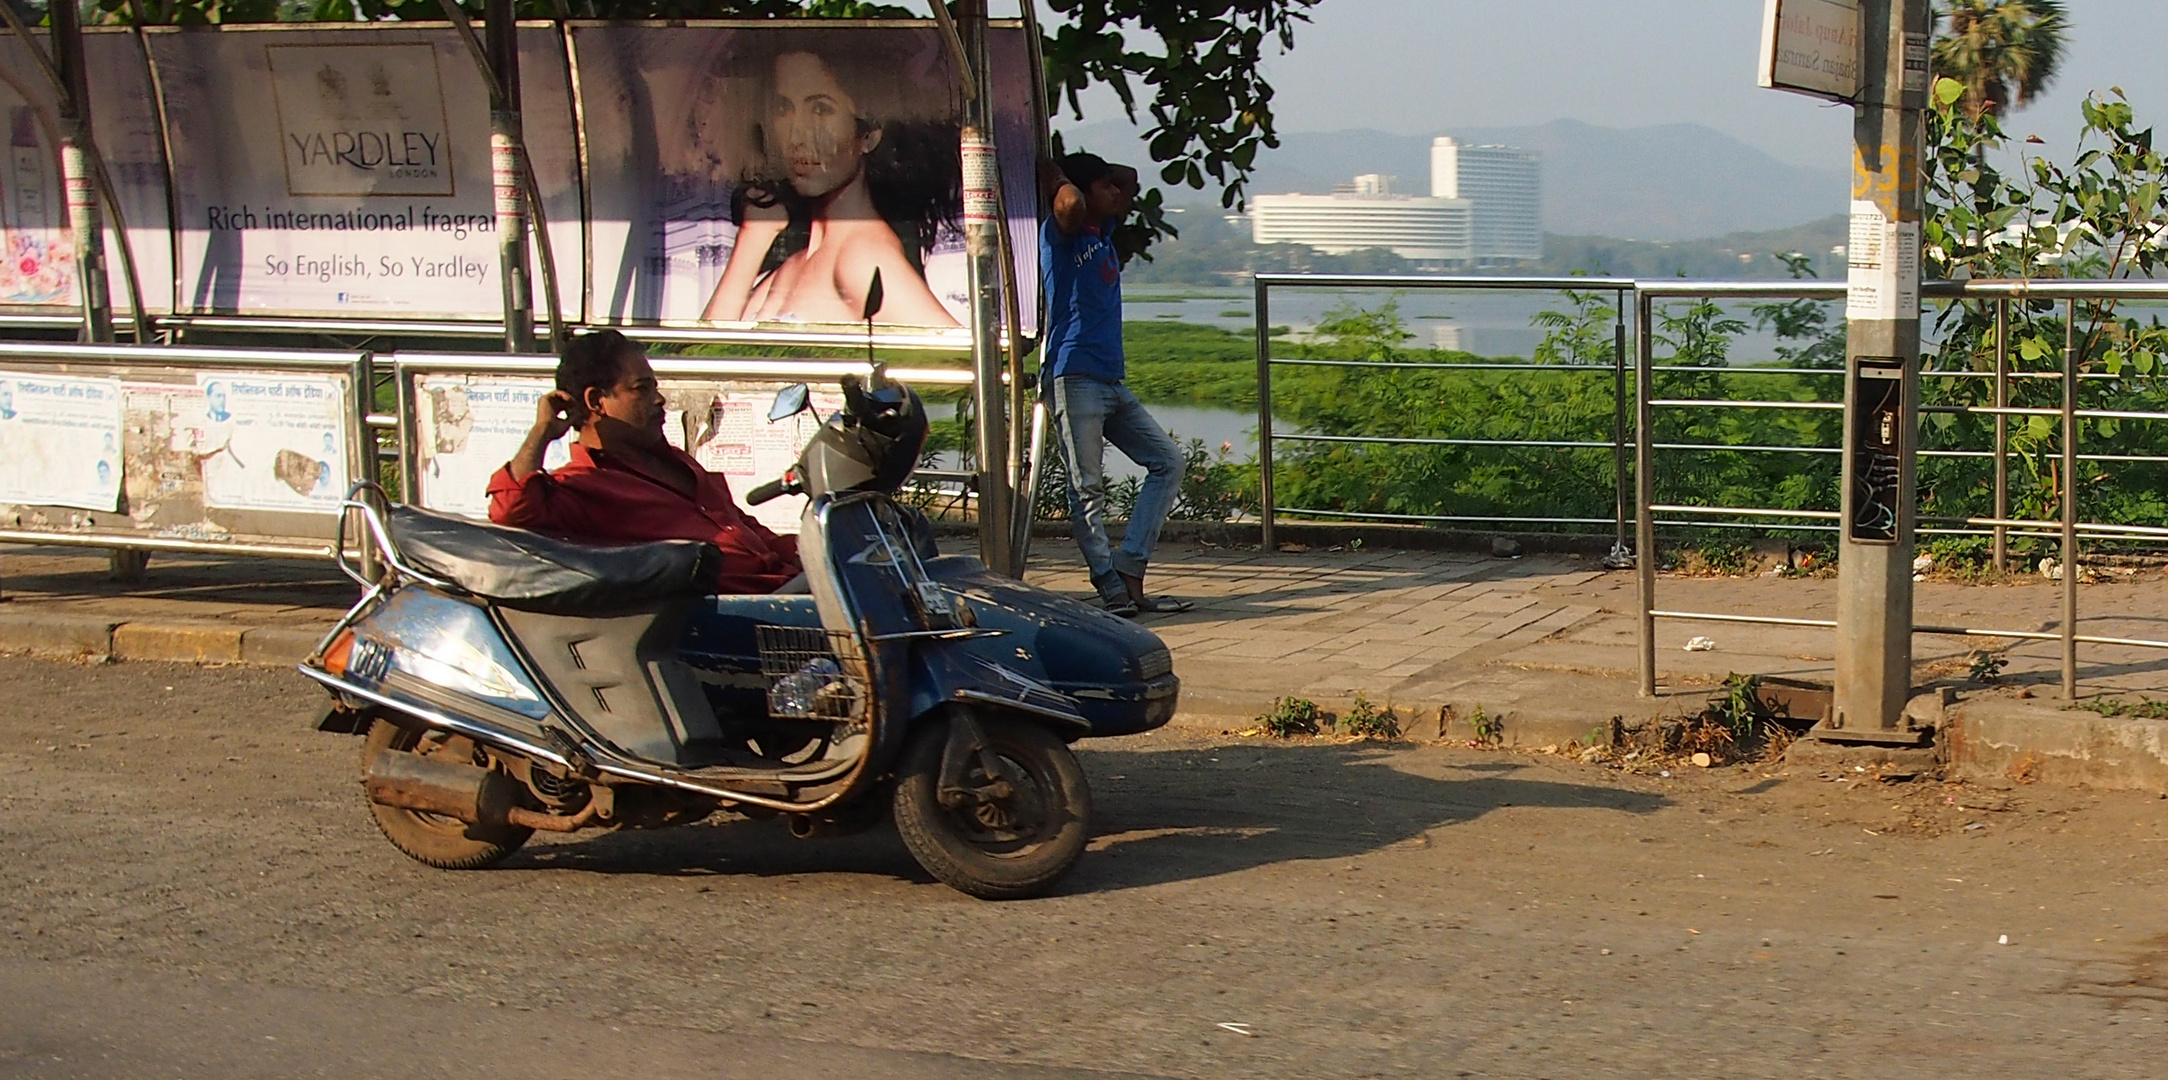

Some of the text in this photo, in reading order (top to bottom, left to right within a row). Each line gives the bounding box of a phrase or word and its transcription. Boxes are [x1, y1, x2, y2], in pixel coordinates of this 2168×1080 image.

[291, 132, 440, 170] YARDLEY
[389, 169, 437, 179] LONDON
[208, 204, 257, 230] Rich
[265, 205, 413, 231] international
[265, 254, 489, 285] So English, So Yardley
